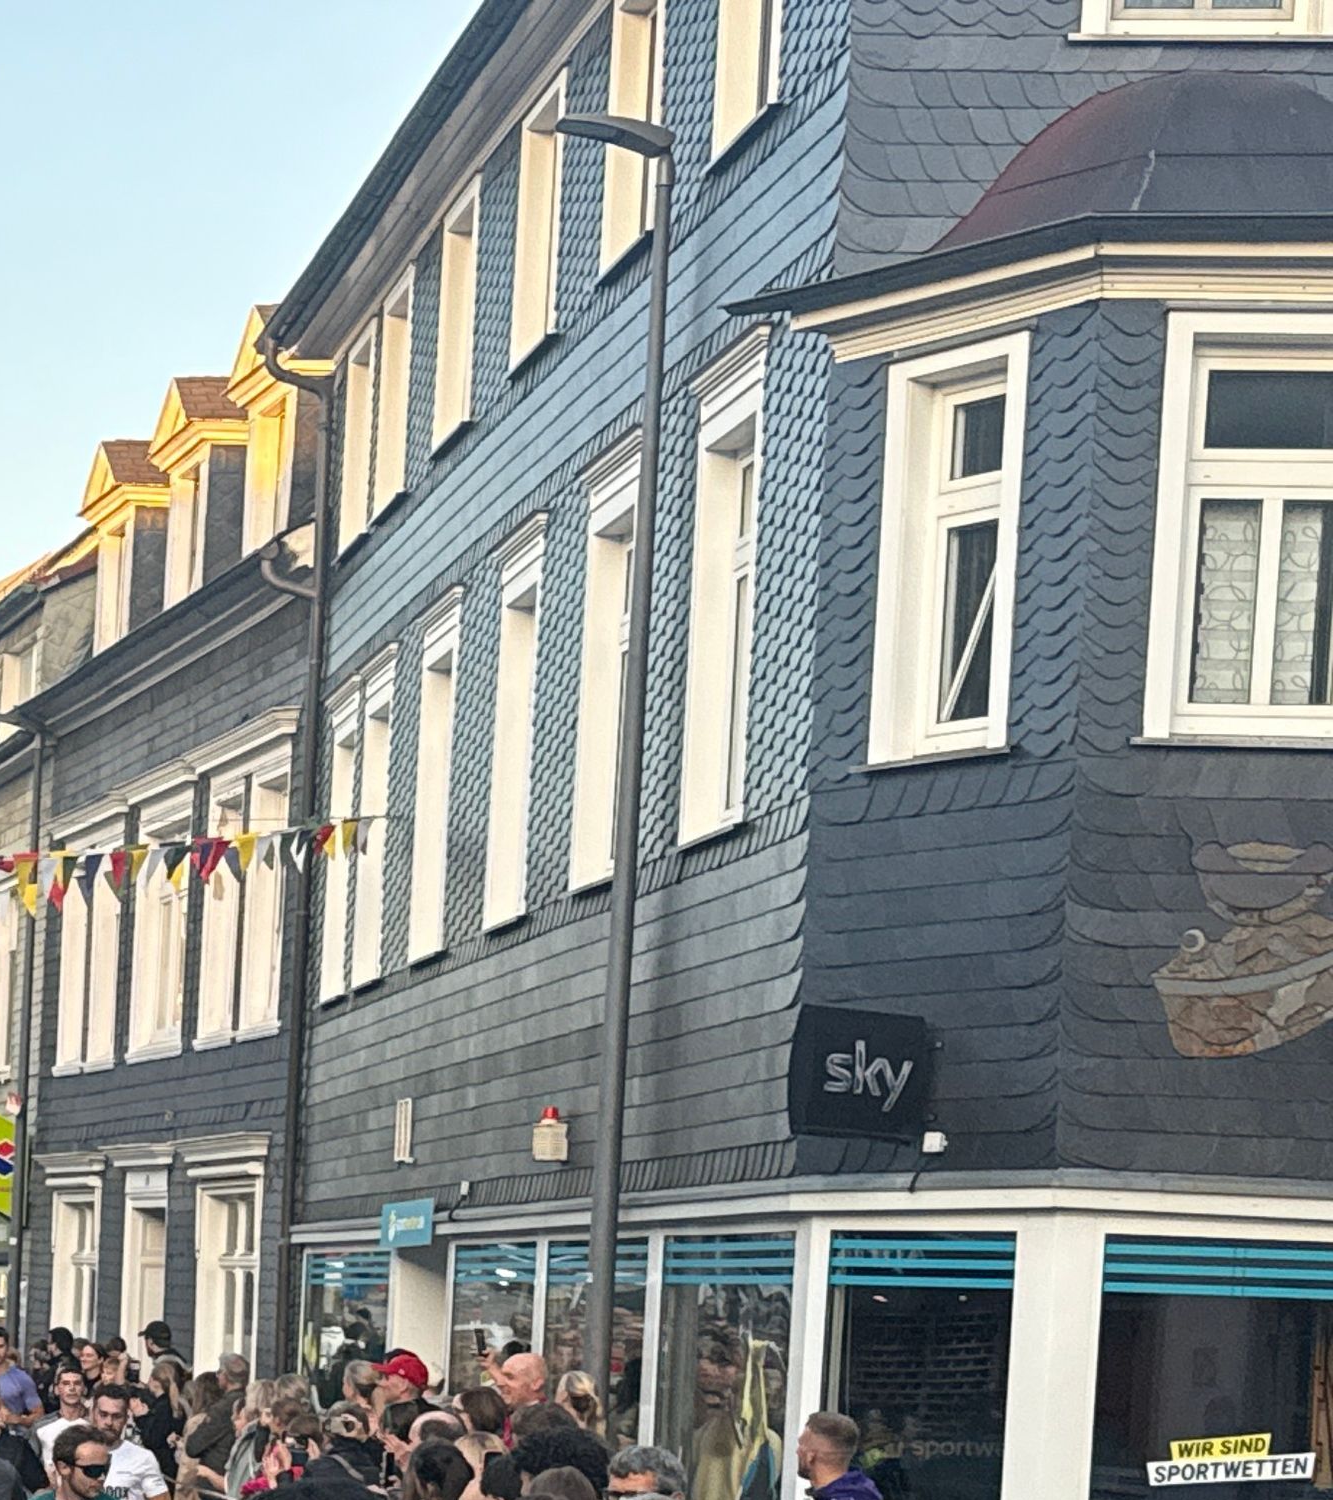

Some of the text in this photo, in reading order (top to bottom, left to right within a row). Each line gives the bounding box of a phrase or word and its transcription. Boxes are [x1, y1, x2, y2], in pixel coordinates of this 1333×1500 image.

[823, 1040, 913, 1112] sky
[912, 1440, 1001, 1460] sportw
[1178, 1437, 1266, 1458] WIR SIND
[1154, 1456, 1308, 1484] SPORTWETTEN
